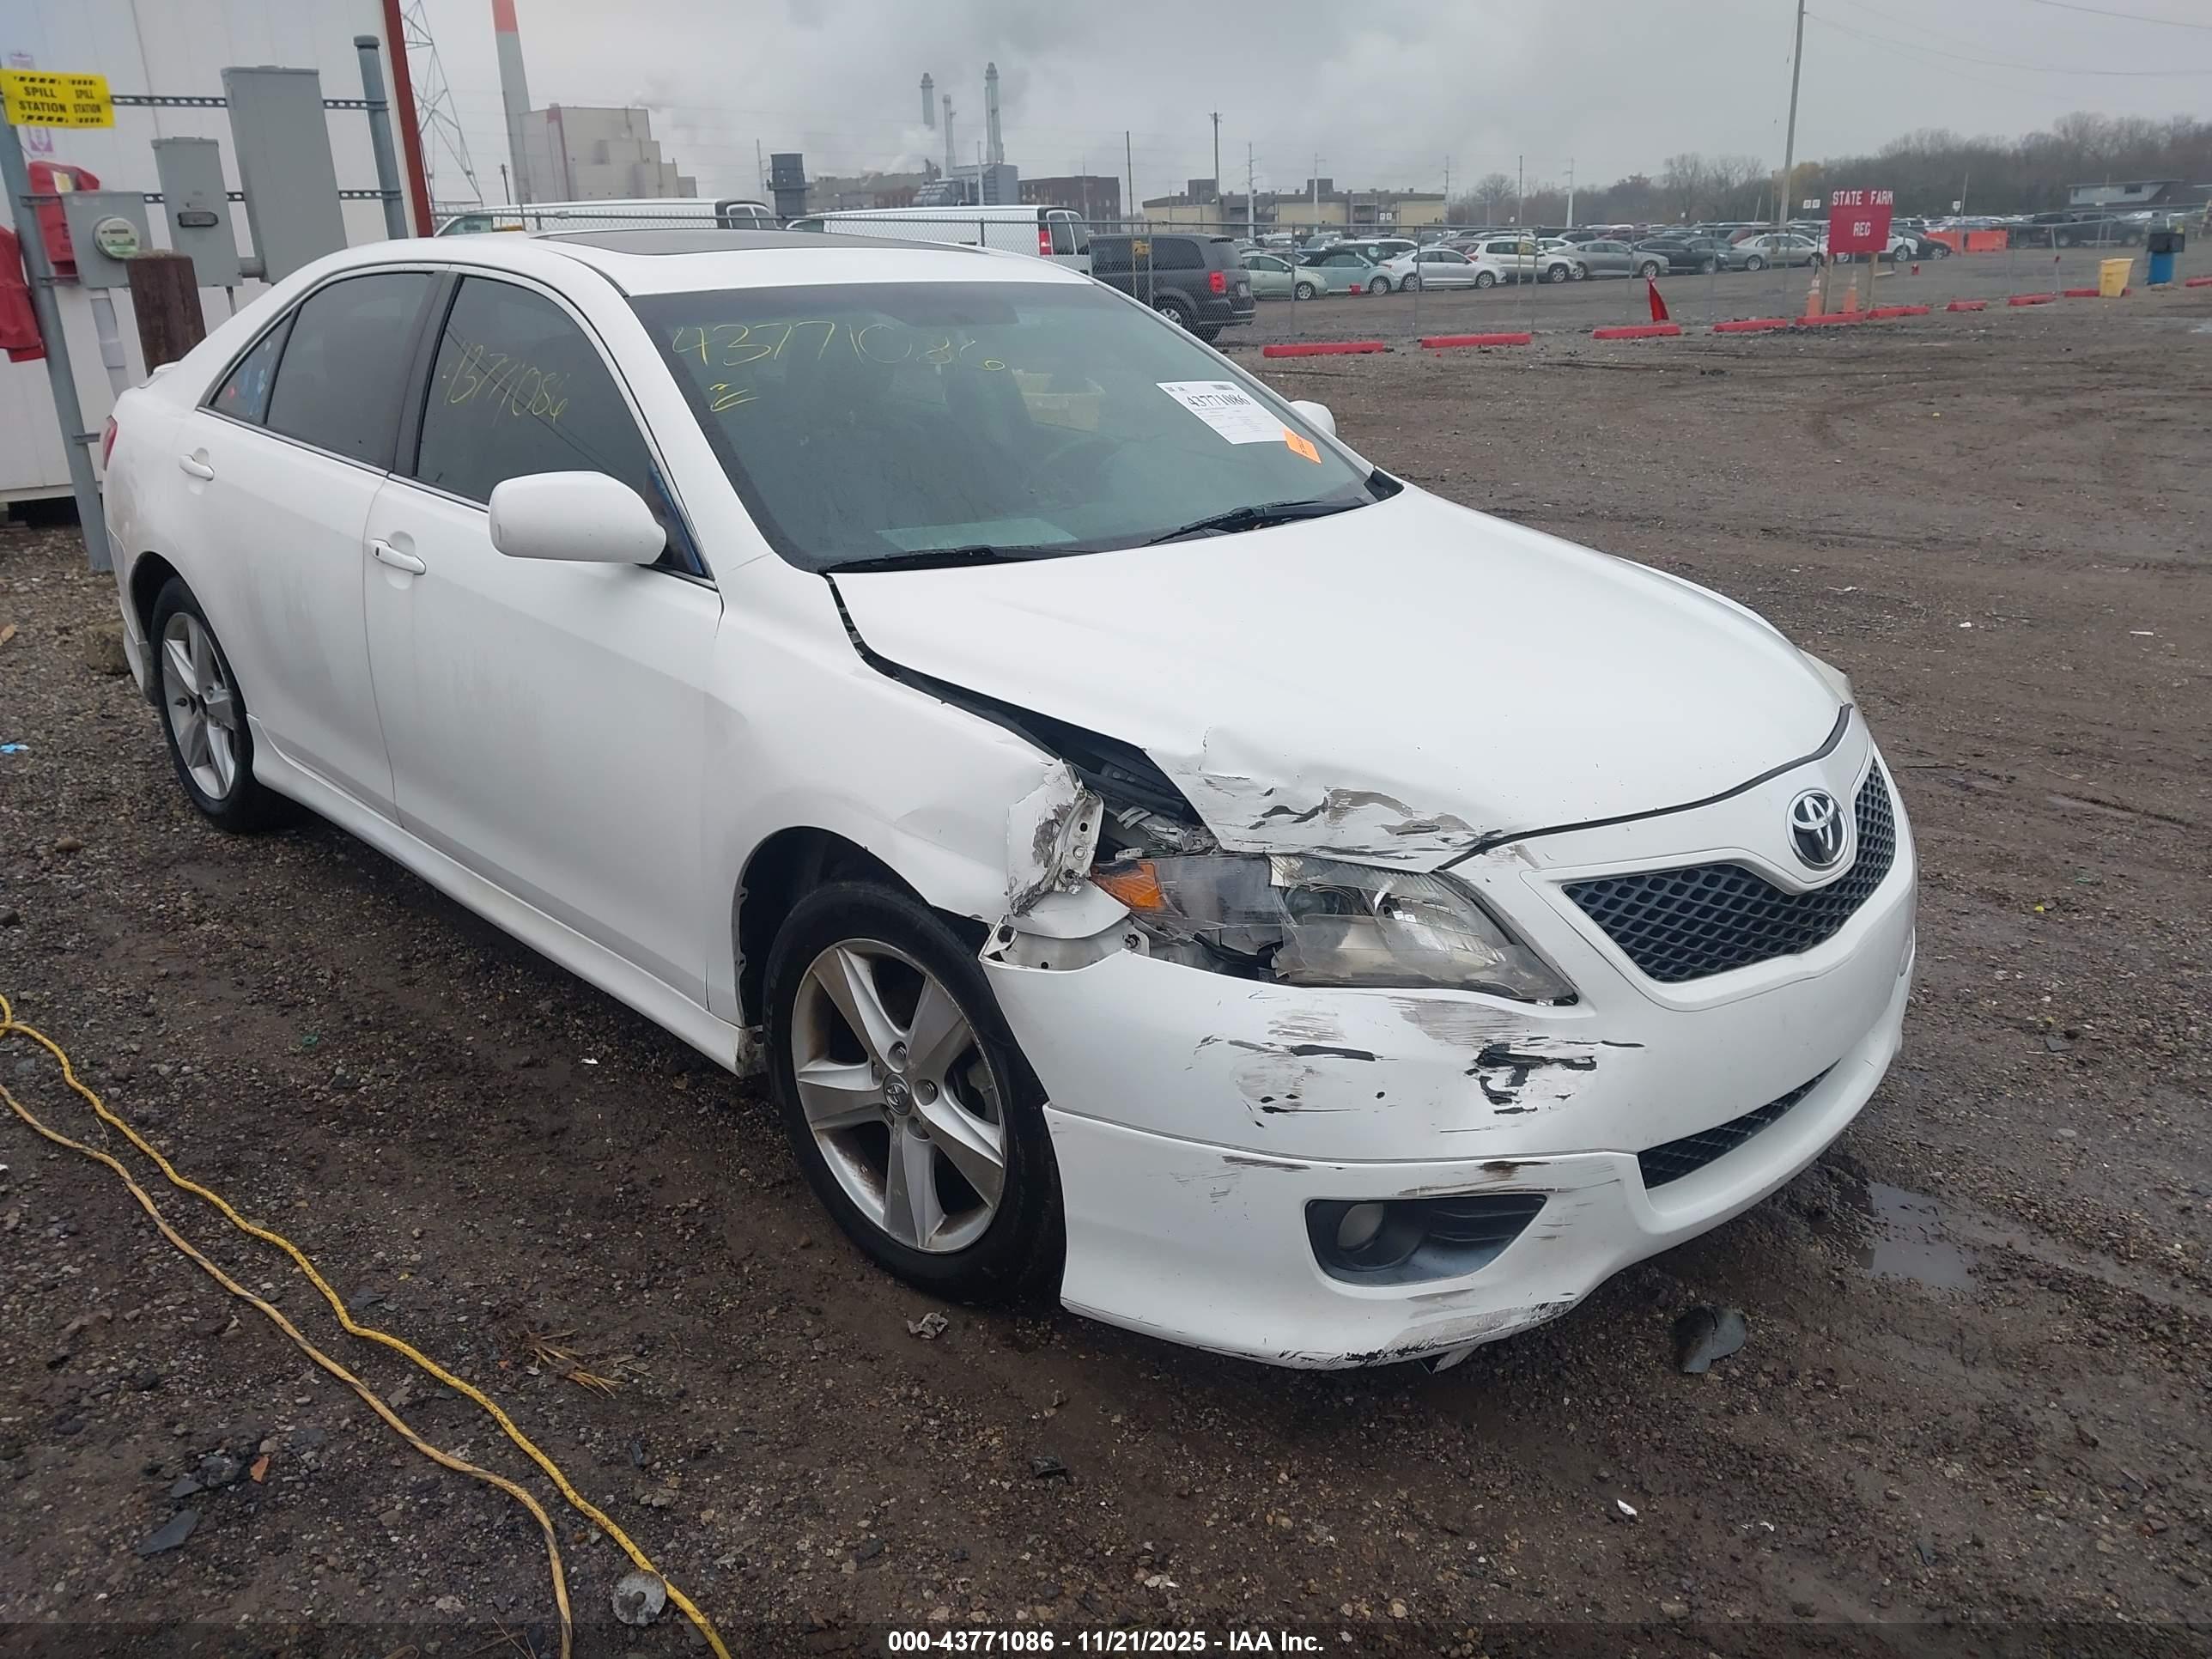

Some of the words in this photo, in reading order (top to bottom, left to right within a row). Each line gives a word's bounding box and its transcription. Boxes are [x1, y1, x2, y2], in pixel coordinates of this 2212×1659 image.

[23, 87, 57, 98] SPILL
[75, 89, 95, 100] SPILL
[18, 100, 67, 112] STATION
[73, 103, 101, 113] STATION
[1832, 190, 1863, 205] STATE
[1869, 190, 1894, 205] FARM
[1186, 394, 1252, 407] 43771086
